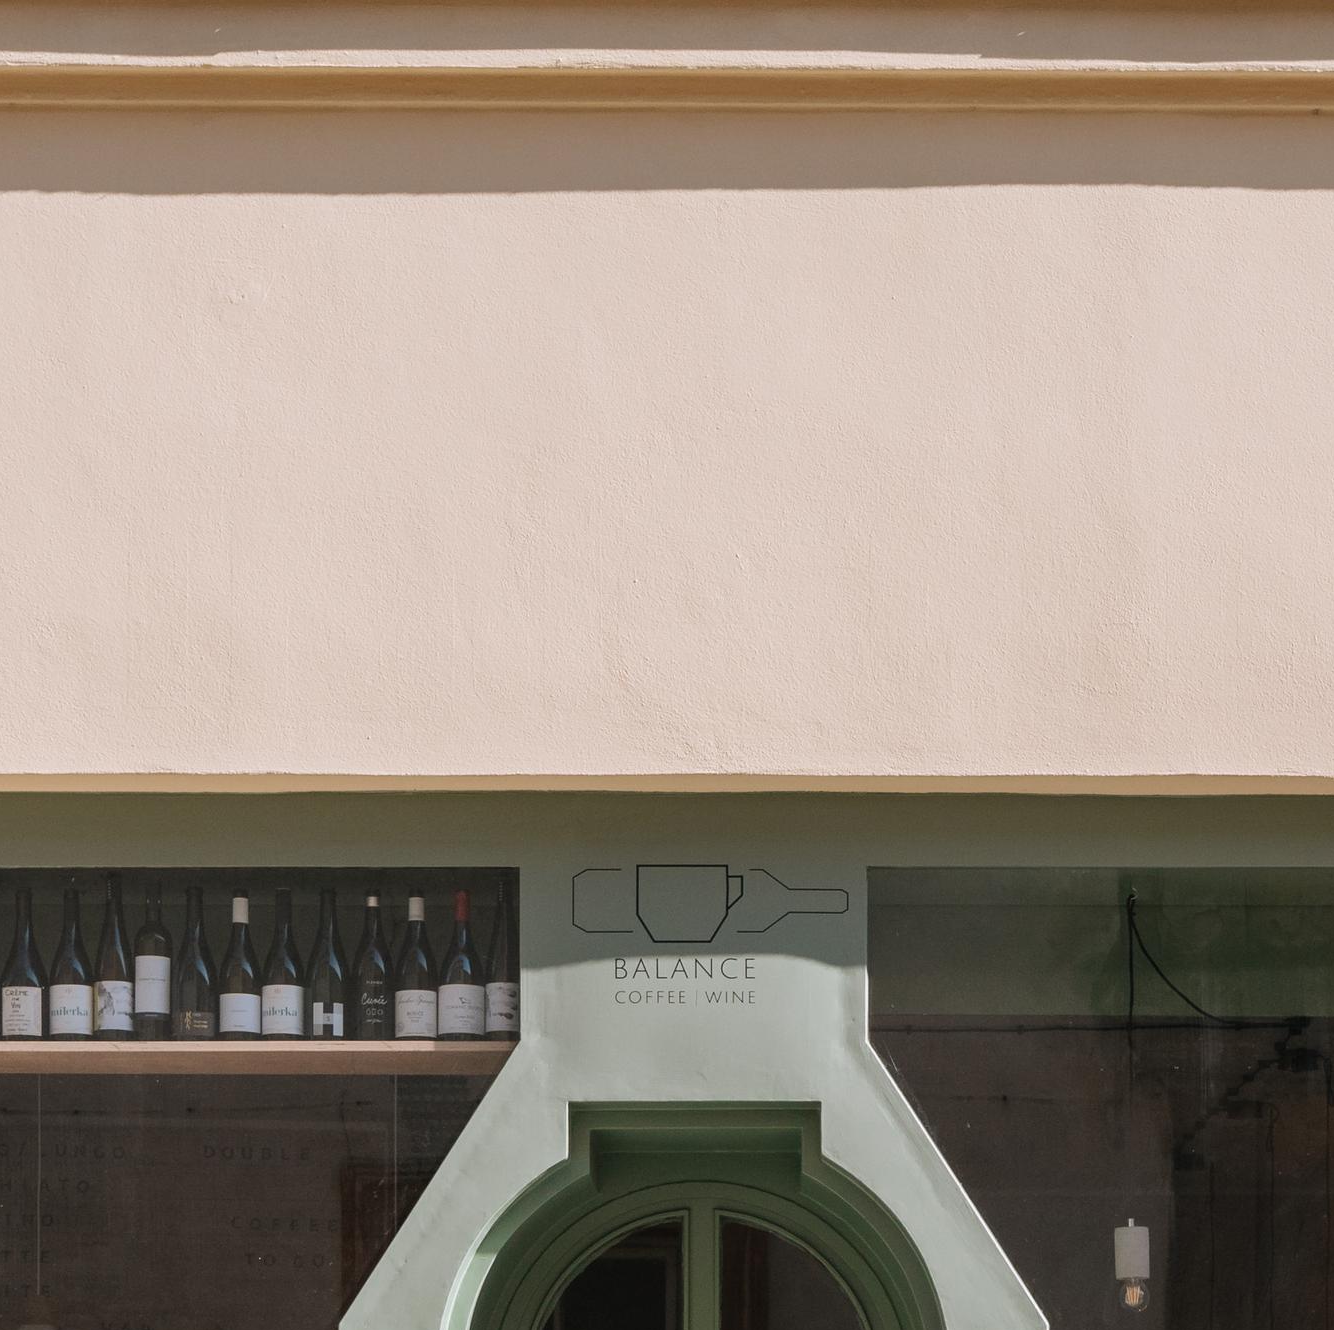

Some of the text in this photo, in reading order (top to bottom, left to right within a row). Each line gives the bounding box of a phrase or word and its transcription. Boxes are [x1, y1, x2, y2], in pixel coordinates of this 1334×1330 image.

[614, 958, 756, 979] BALANCE
[614, 990, 756, 1005] COFFEE WINE
[202, 1144, 312, 1161] DOUBLE
[230, 1216, 339, 1233] COFFEE
